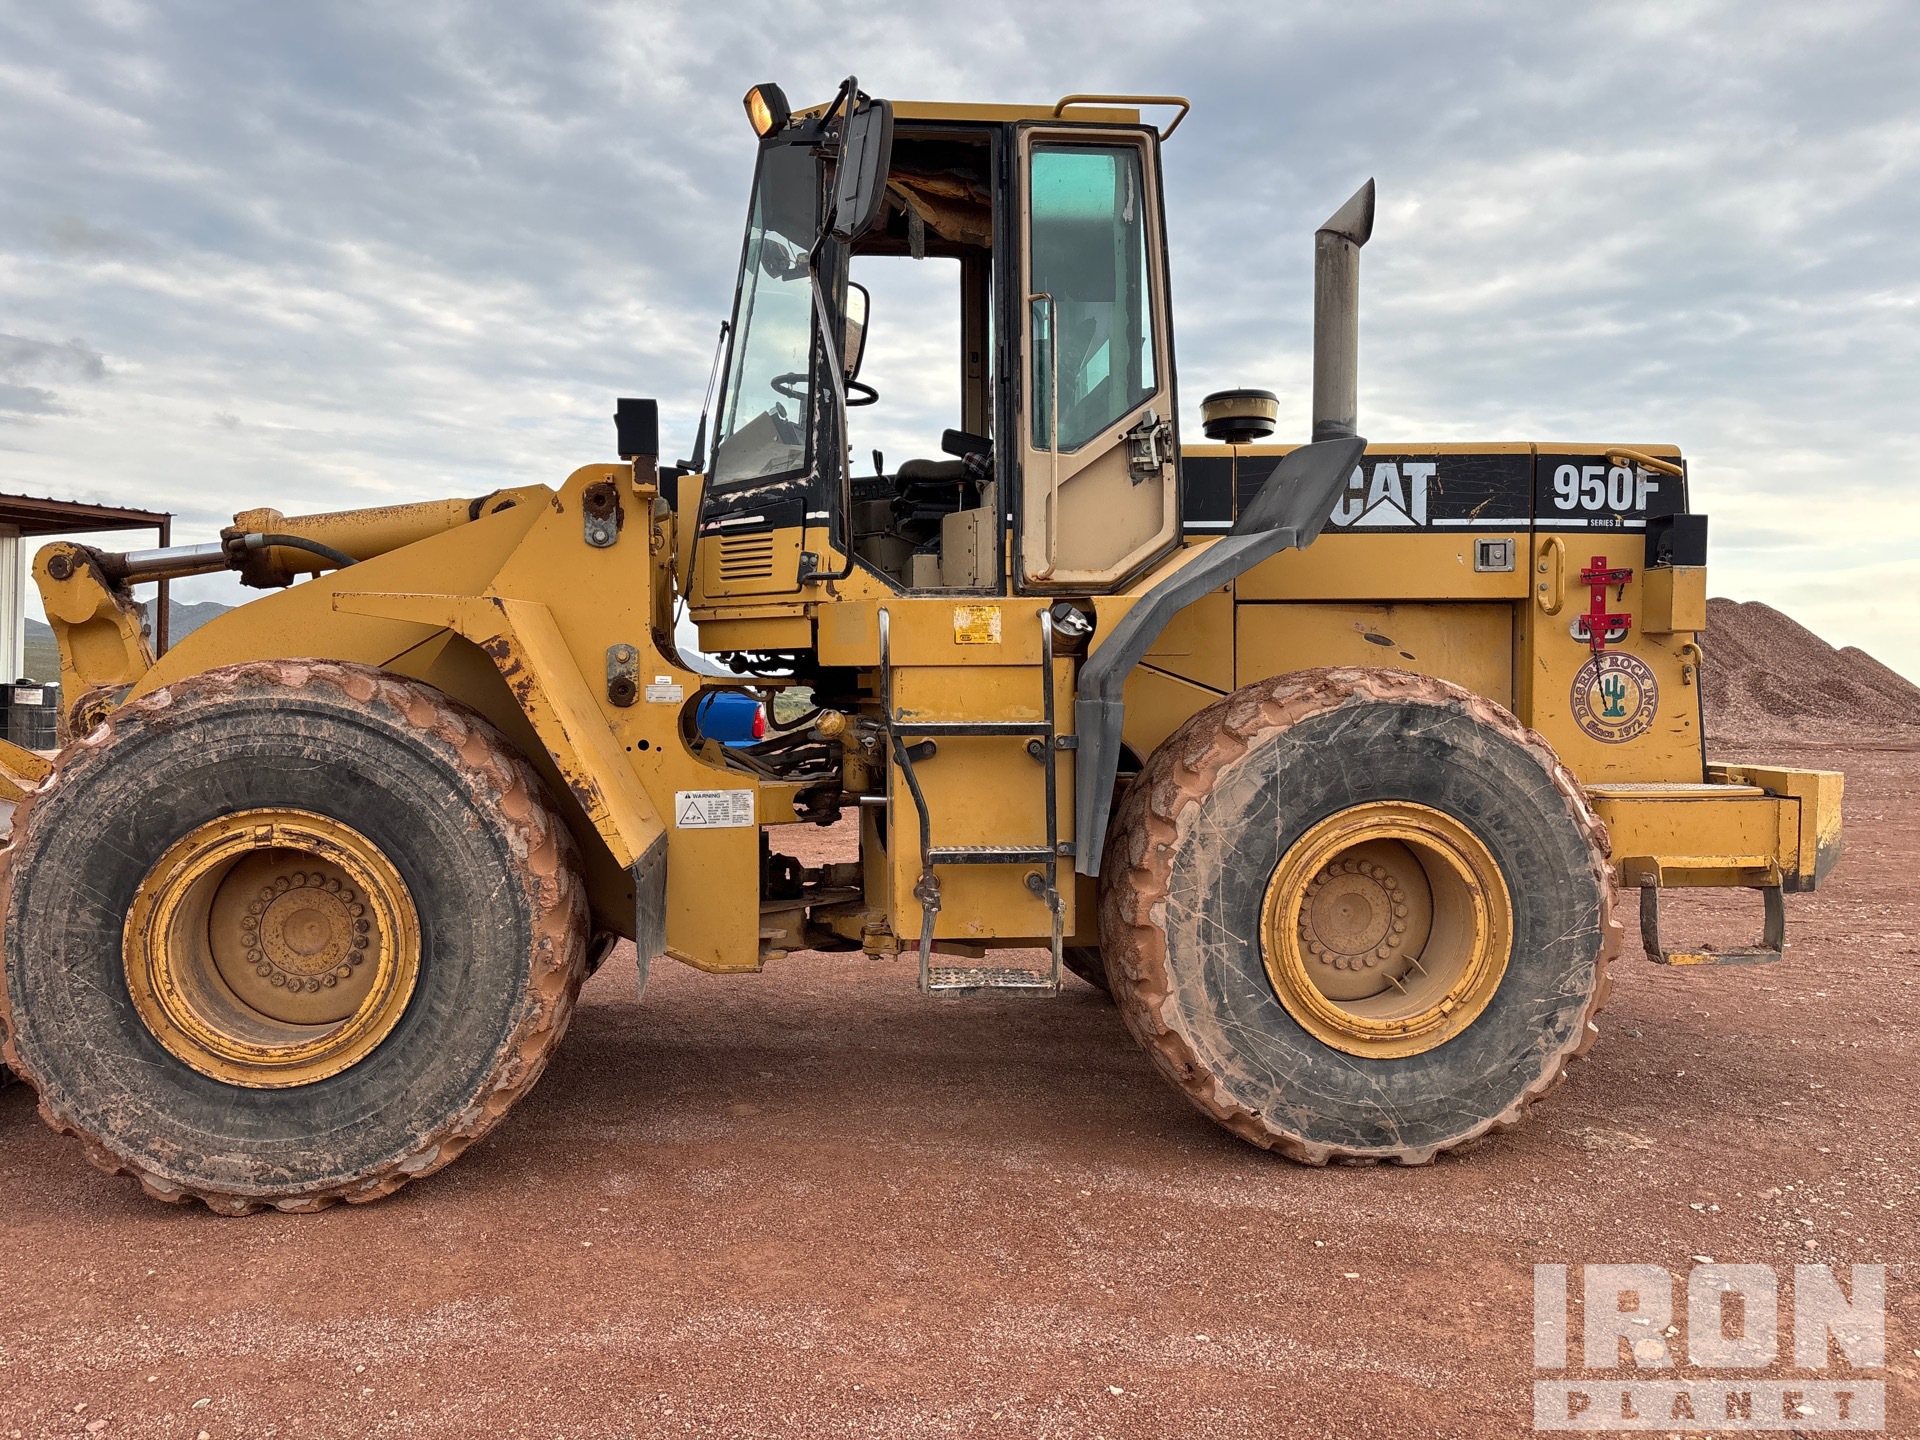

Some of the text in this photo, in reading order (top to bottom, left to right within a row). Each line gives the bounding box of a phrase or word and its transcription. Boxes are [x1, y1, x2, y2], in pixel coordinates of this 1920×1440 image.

[1330, 463, 1436, 526] CAT
[1554, 464, 1660, 511] 950F
[1590, 519, 1614, 527] SERIES
[1575, 656, 1654, 720] DESERT ROCK INC
[1586, 719, 1645, 738] Since 1972
